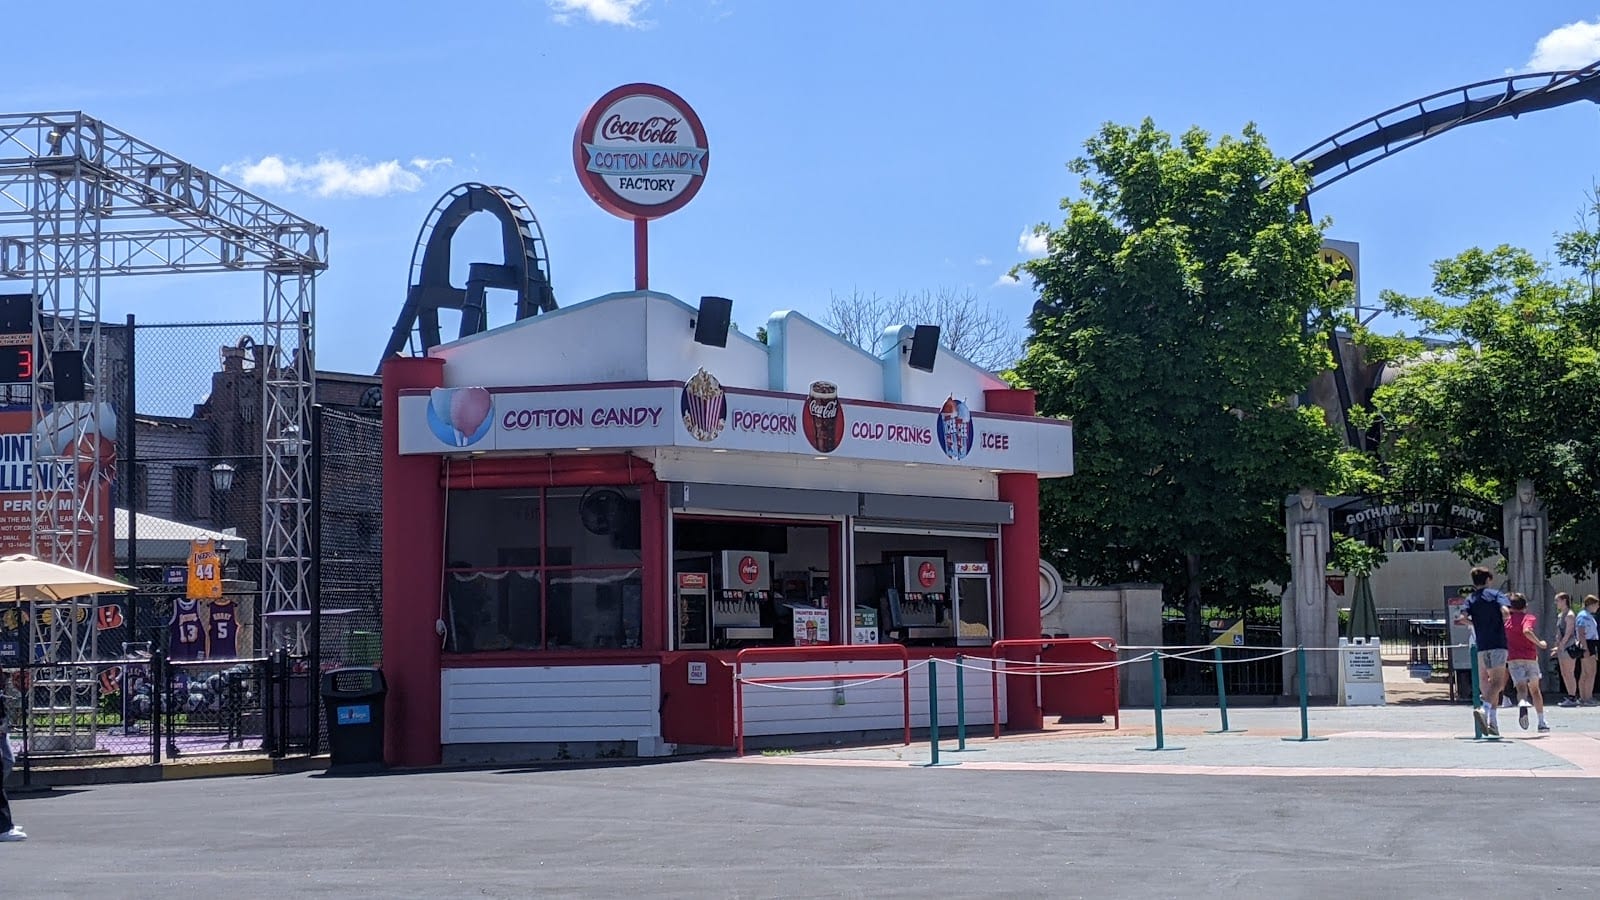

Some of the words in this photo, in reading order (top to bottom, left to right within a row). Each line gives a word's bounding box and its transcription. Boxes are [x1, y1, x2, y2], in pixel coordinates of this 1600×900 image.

[601, 114, 682, 144] Coca-Cola
[594, 152, 647, 170] COTTON
[652, 152, 699, 169] CANDY
[619, 177, 676, 191] FACTORY
[18, 350, 32, 378] 3
[503, 408, 584, 428] COTTON
[591, 406, 663, 426] CANDY
[732, 411, 797, 432] POPCORN
[851, 422, 884, 440] COLD
[887, 424, 932, 444] DRINKS
[981, 432, 1009, 450] ICEE
[3, 500, 32, 511] PER
[1345, 505, 1400, 524] GOTHAM
[1411, 503, 1440, 514] CITY
[1450, 505, 1486, 521] PARK
[196, 564, 214, 580] 44
[180, 624, 198, 643] 13
[217, 622, 228, 639] 5
